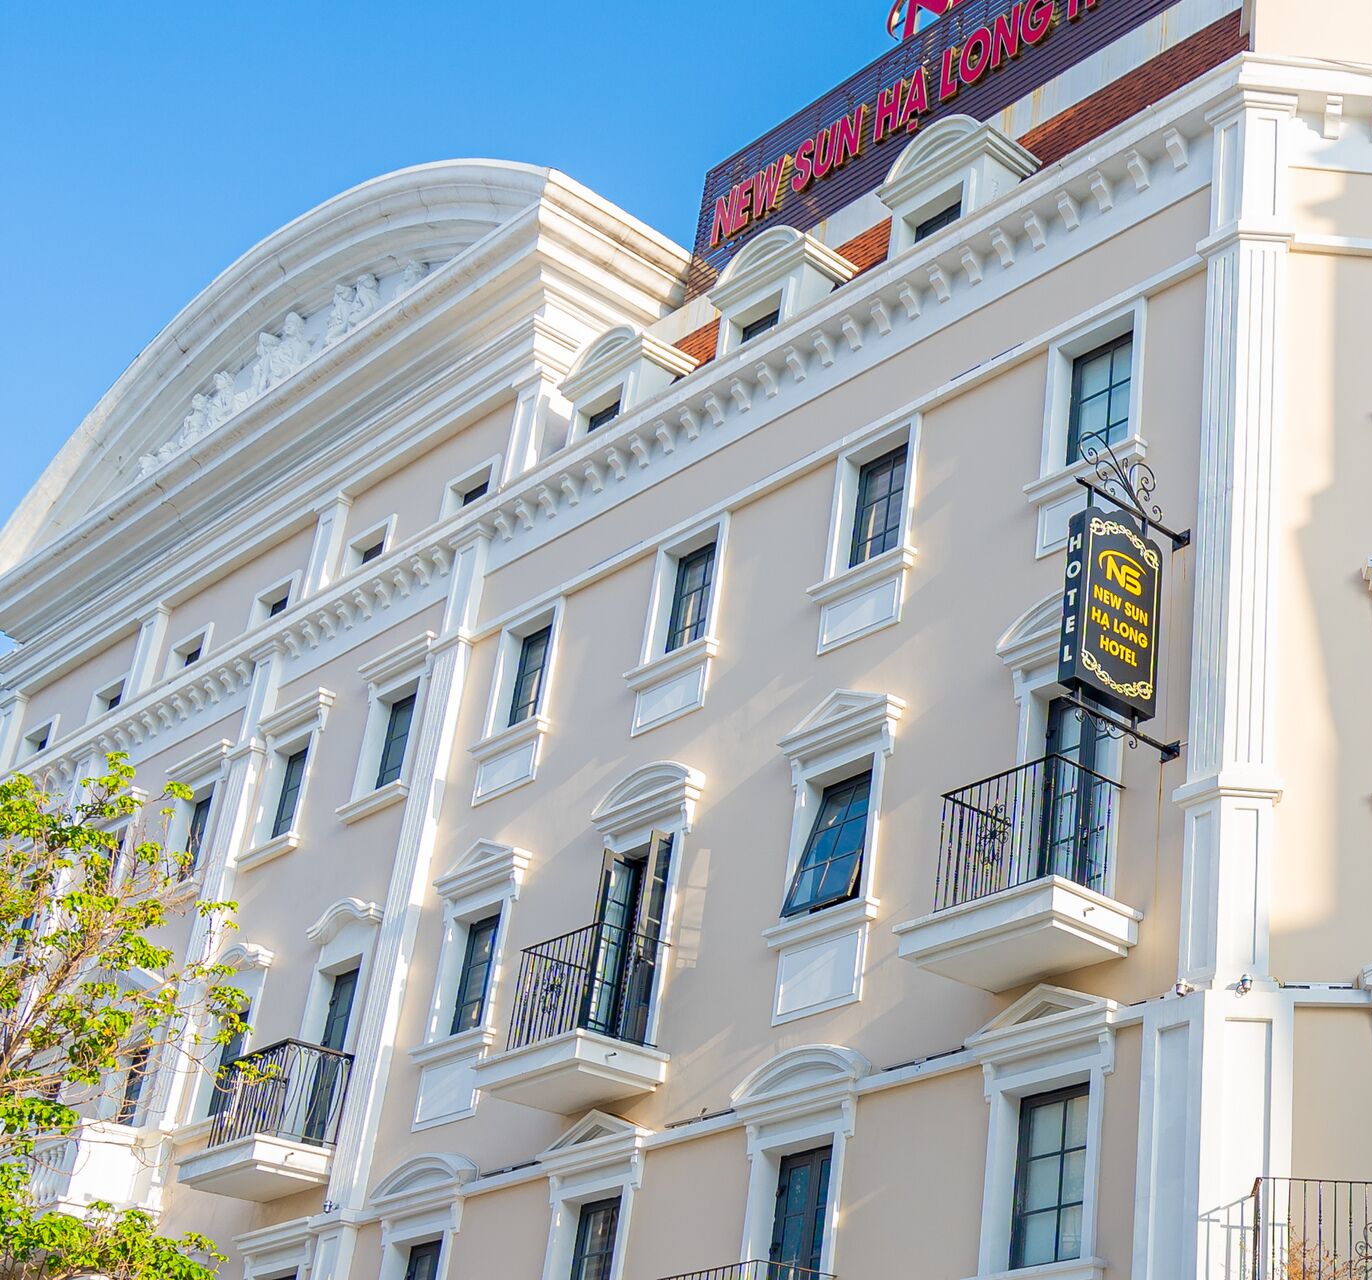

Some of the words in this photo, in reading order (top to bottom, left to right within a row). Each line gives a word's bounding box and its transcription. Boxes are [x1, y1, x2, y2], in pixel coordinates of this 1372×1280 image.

[710, 154, 790, 247] NEW
[791, 104, 867, 192] SUN
[873, 65, 930, 143] HẠ
[1062, 532, 1082, 663] HOTEL
[1093, 585, 1122, 610] NEW
[1124, 602, 1148, 627] SUN
[1091, 606, 1110, 630] HẠ
[1113, 617, 1148, 649] LONG
[1100, 634, 1137, 667] HOTEL
